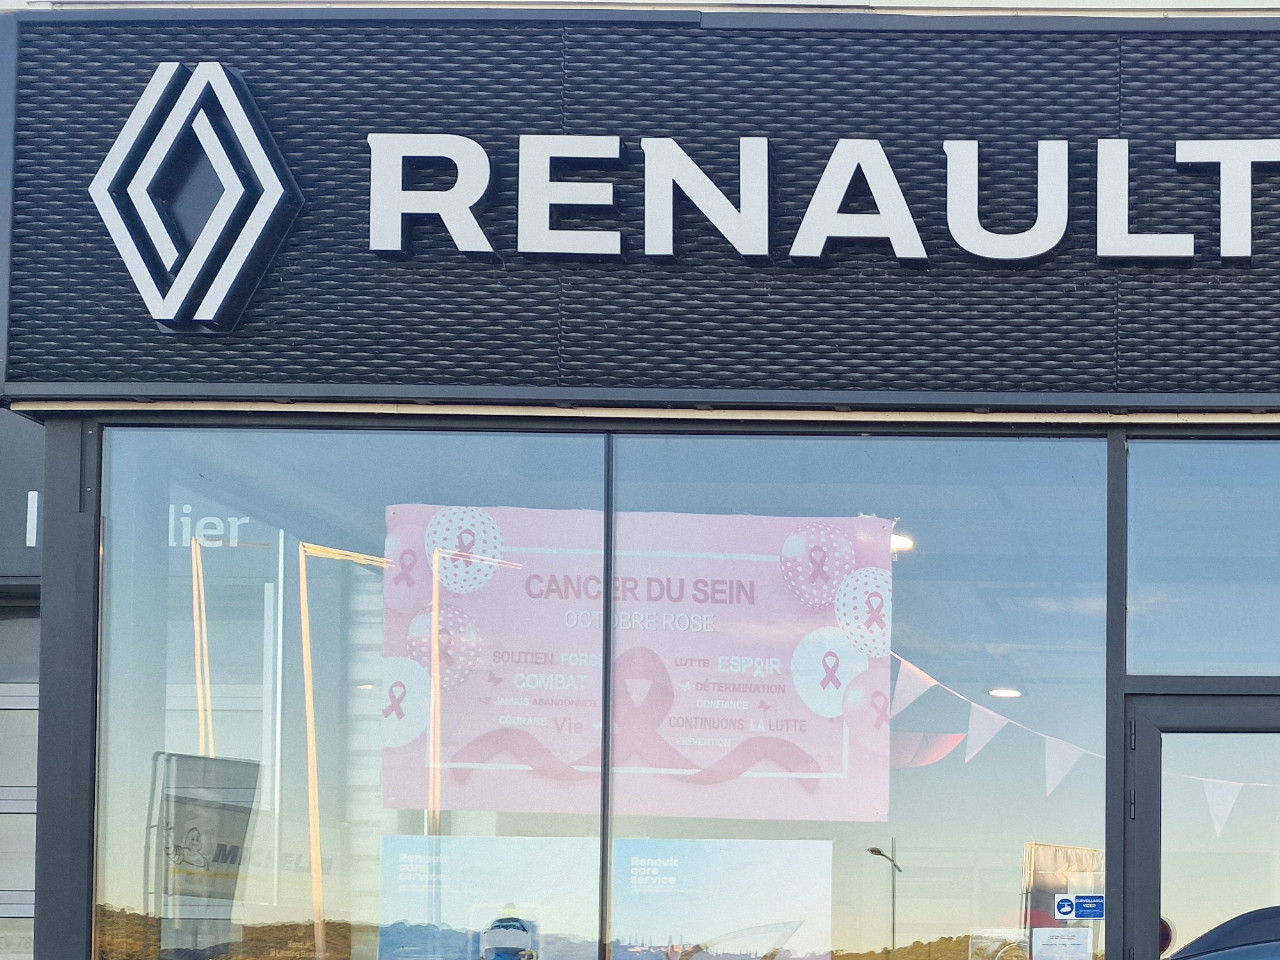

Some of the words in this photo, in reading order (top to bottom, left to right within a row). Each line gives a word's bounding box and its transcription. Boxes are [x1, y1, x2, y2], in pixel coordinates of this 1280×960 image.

[525, 574, 640, 601] CANCER
[646, 577, 684, 602] DU
[691, 579, 755, 605] SEIN
[664, 613, 715, 632] ROSE
[493, 650, 553, 665] SOUTIEN
[675, 657, 709, 668] LUTTE
[513, 673, 588, 690] COMBAT
[695, 680, 786, 694] DÉTERMINATION
[554, 717, 585, 734] Vie
[669, 716, 745, 731] CONTINUONS
[751, 720, 766, 732] LA
[768, 719, 807, 732] LUTTE
